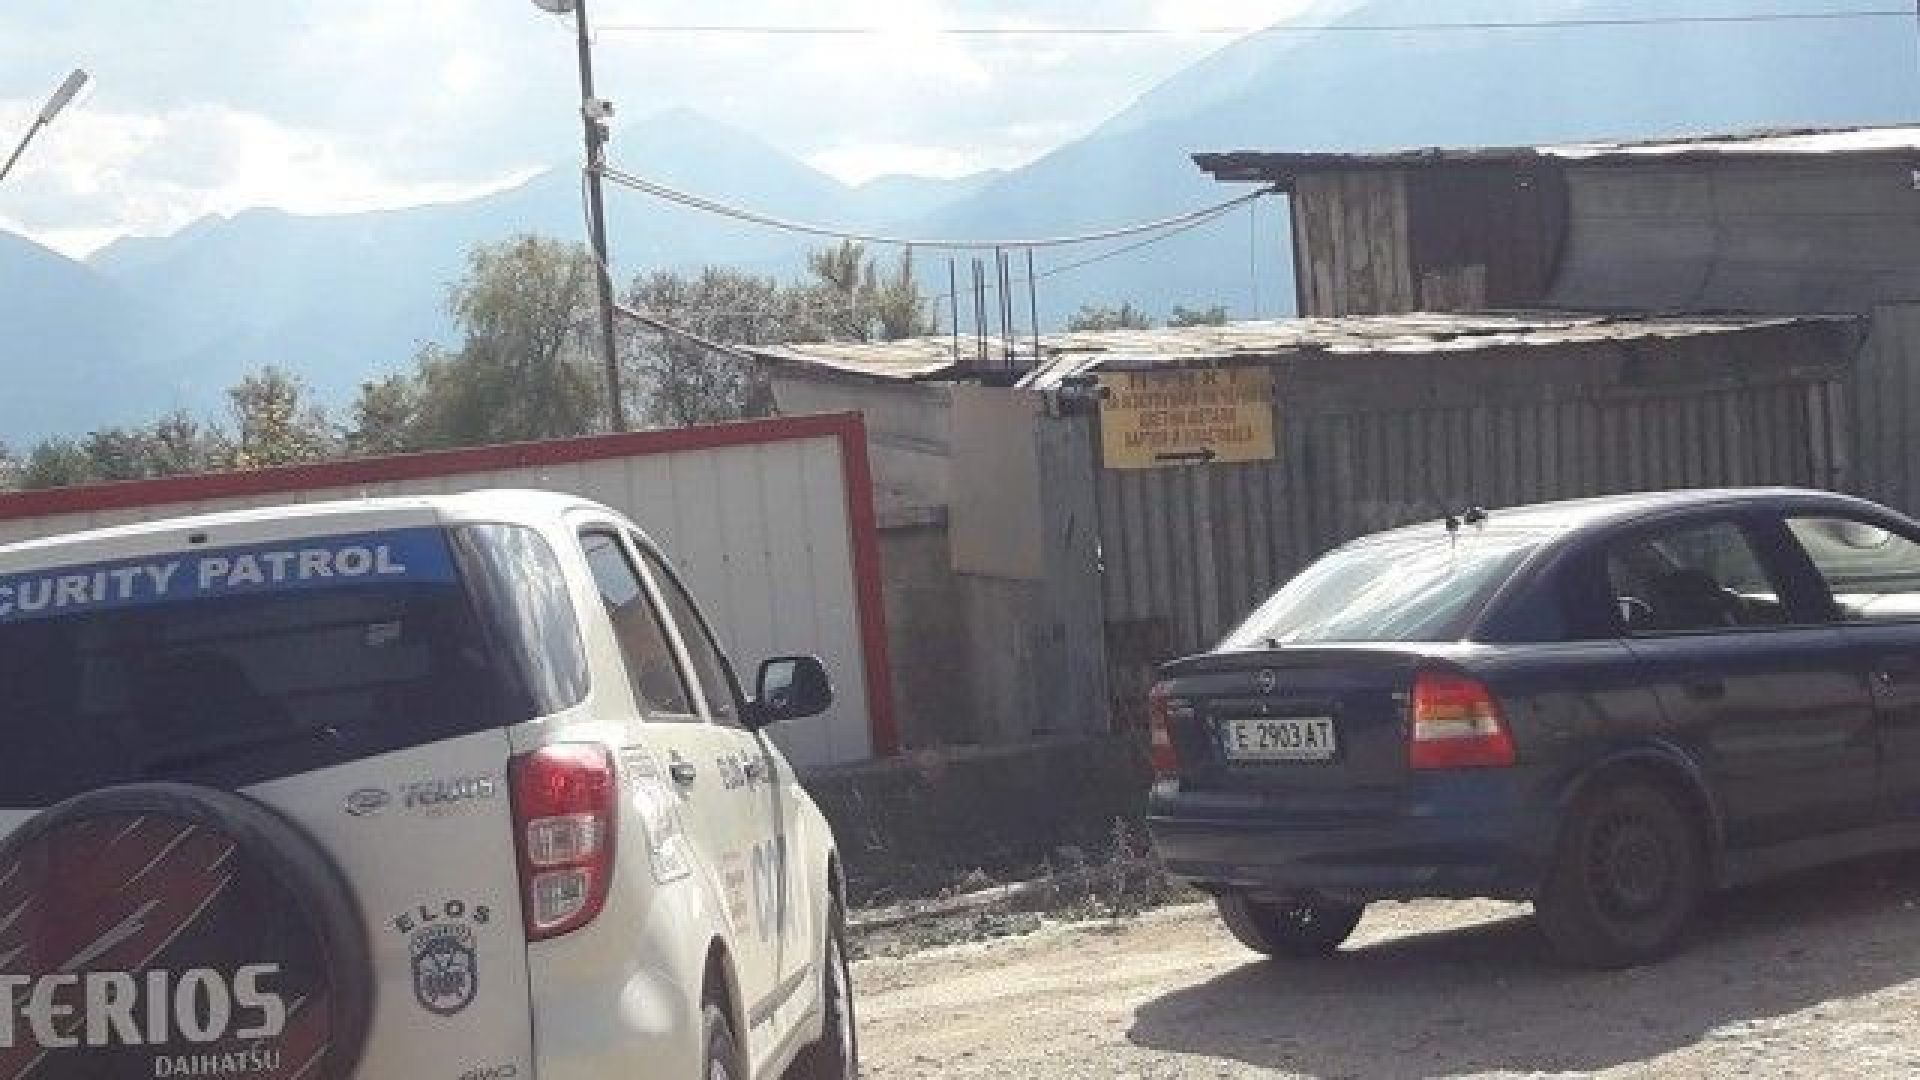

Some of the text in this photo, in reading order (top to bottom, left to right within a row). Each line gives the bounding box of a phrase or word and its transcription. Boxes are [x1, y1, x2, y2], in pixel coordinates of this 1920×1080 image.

[200, 545, 405, 589] PATROL
[1236, 721, 1329, 748] E 2903 AT
[396, 899, 492, 934] ELOS
[0, 963, 286, 1047] TERIOS
[155, 1050, 280, 1076] DAIHATSU
